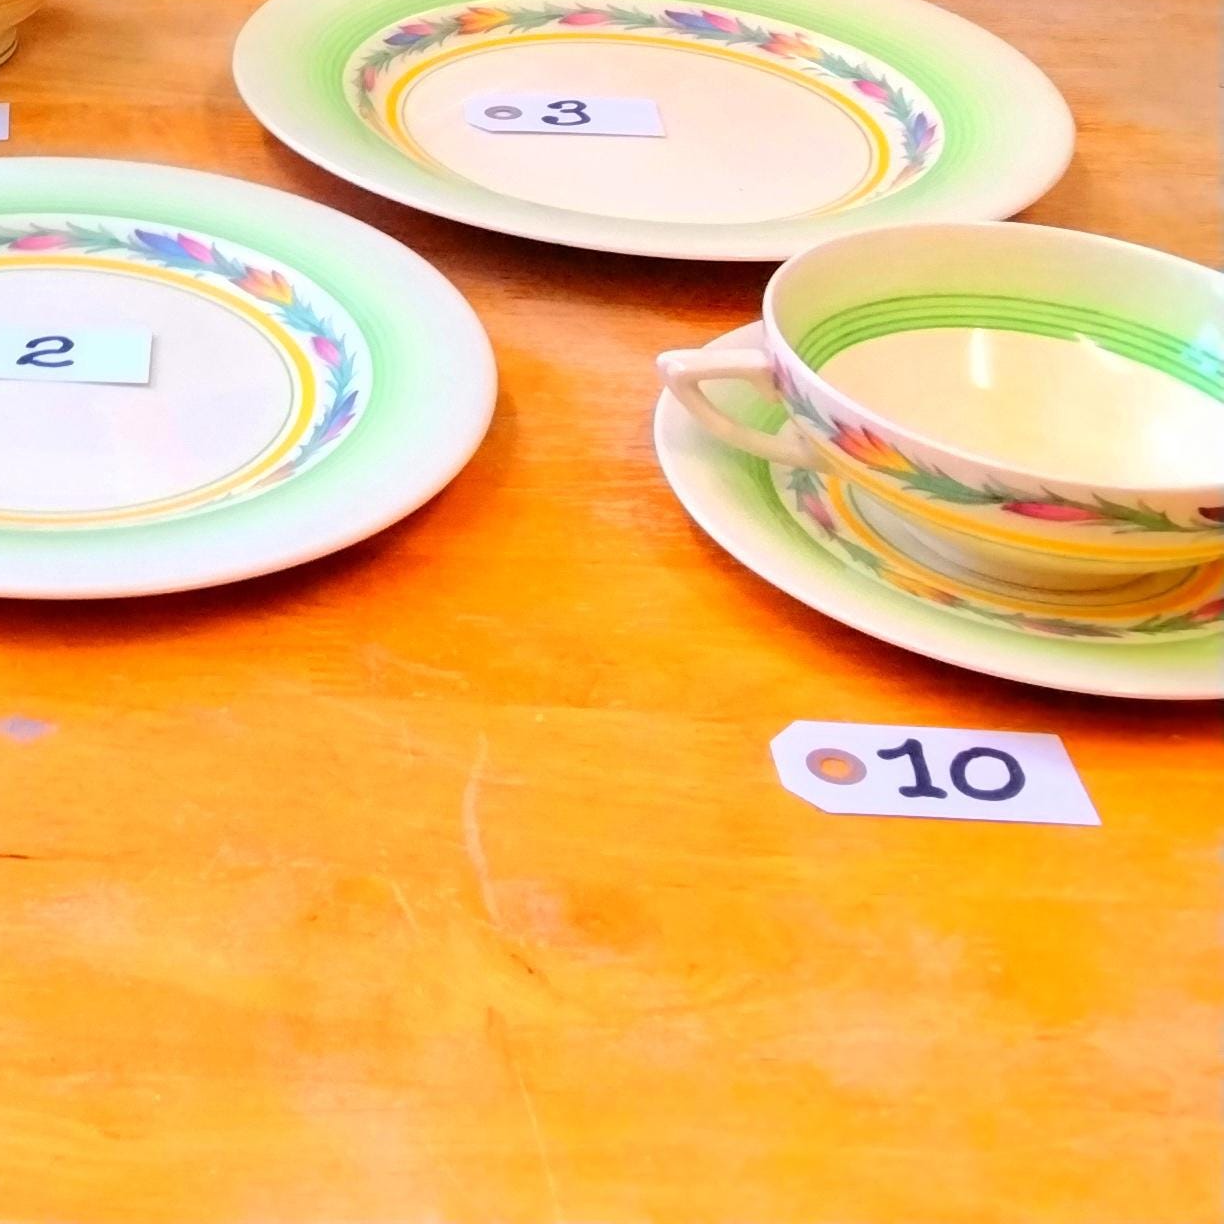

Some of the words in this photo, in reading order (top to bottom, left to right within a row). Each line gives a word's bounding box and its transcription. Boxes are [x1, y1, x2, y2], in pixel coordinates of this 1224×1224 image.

[541, 99, 591, 126] 3
[16, 335, 74, 368] 2
[876, 738, 1026, 801] 10
